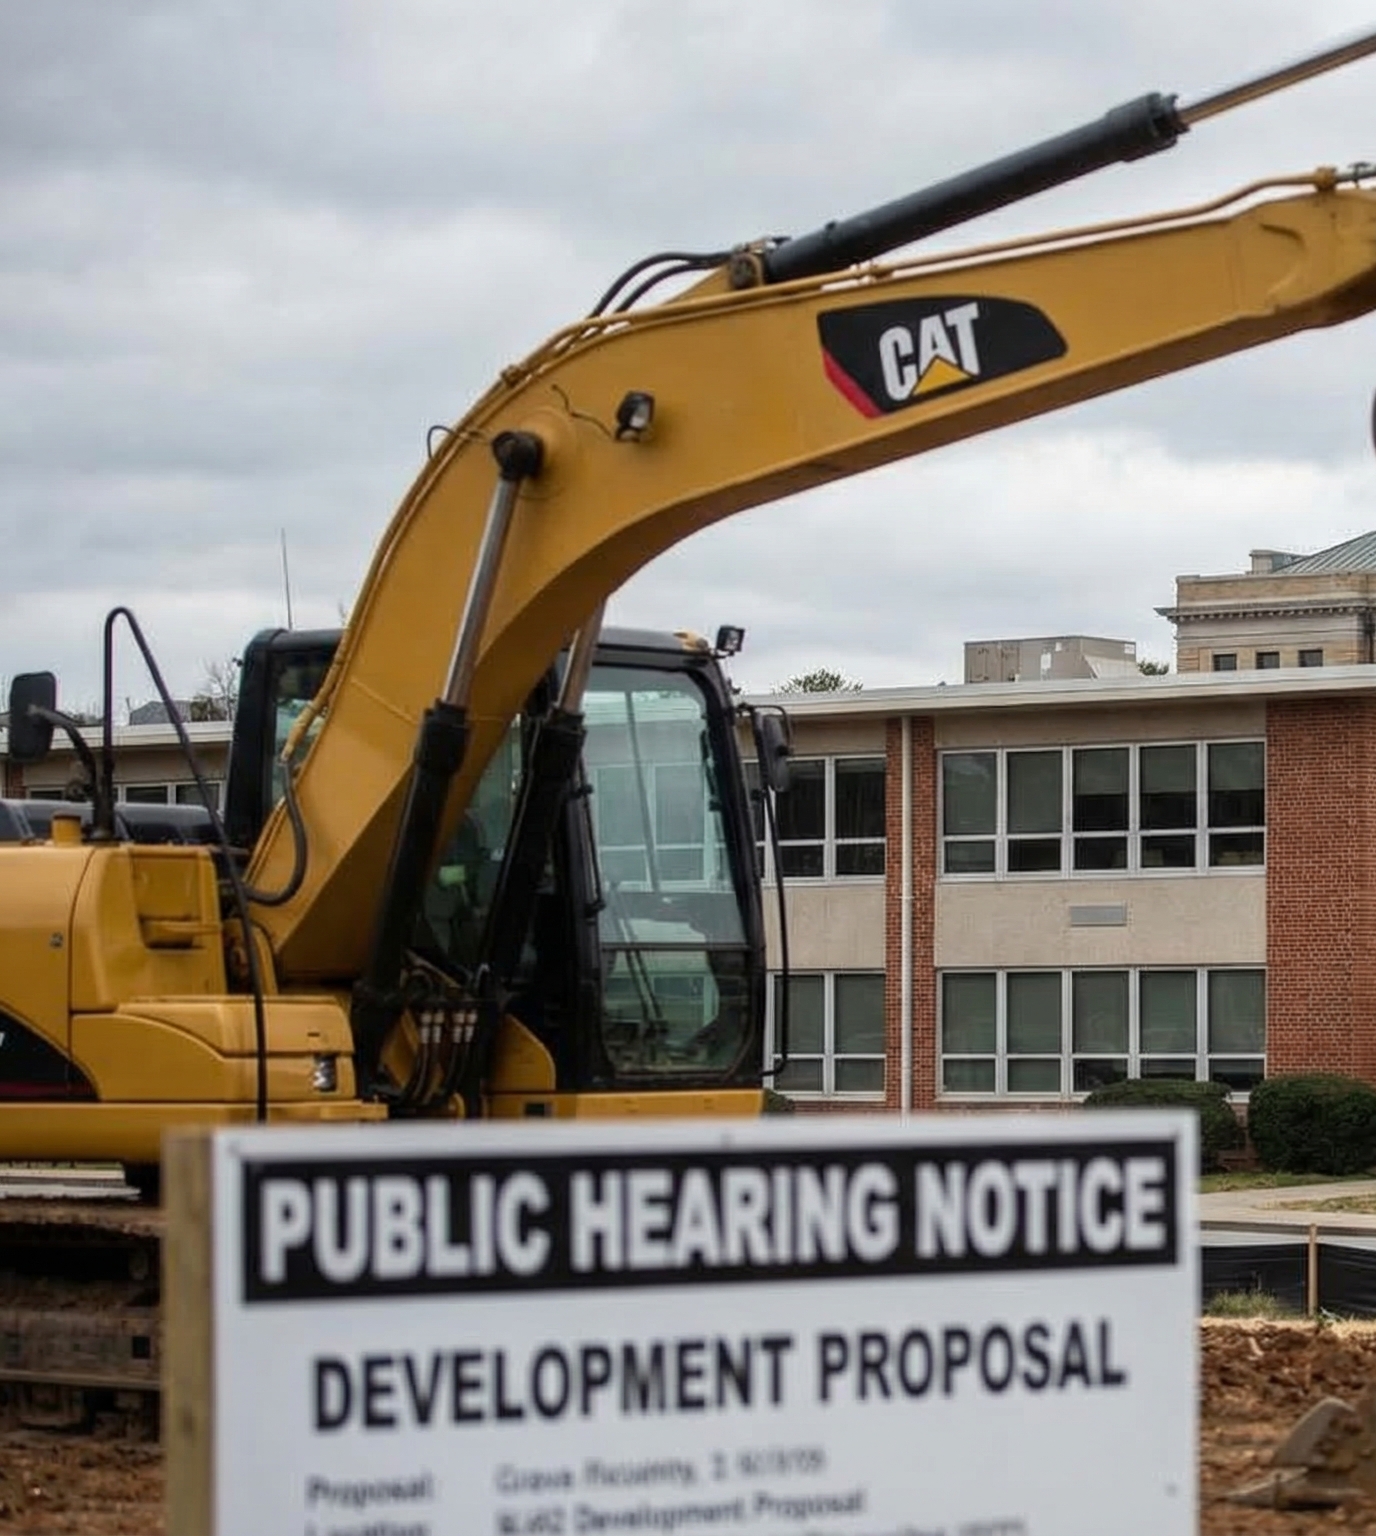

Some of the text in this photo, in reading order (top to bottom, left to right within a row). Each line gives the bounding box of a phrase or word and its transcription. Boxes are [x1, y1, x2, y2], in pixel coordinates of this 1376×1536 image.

[879, 301, 980, 401] CAT
[259, 1156, 1167, 1284] PUBLIC HEARING NOTICE
[312, 1319, 1128, 1434] DEVELOPMENT PROPOSAL
